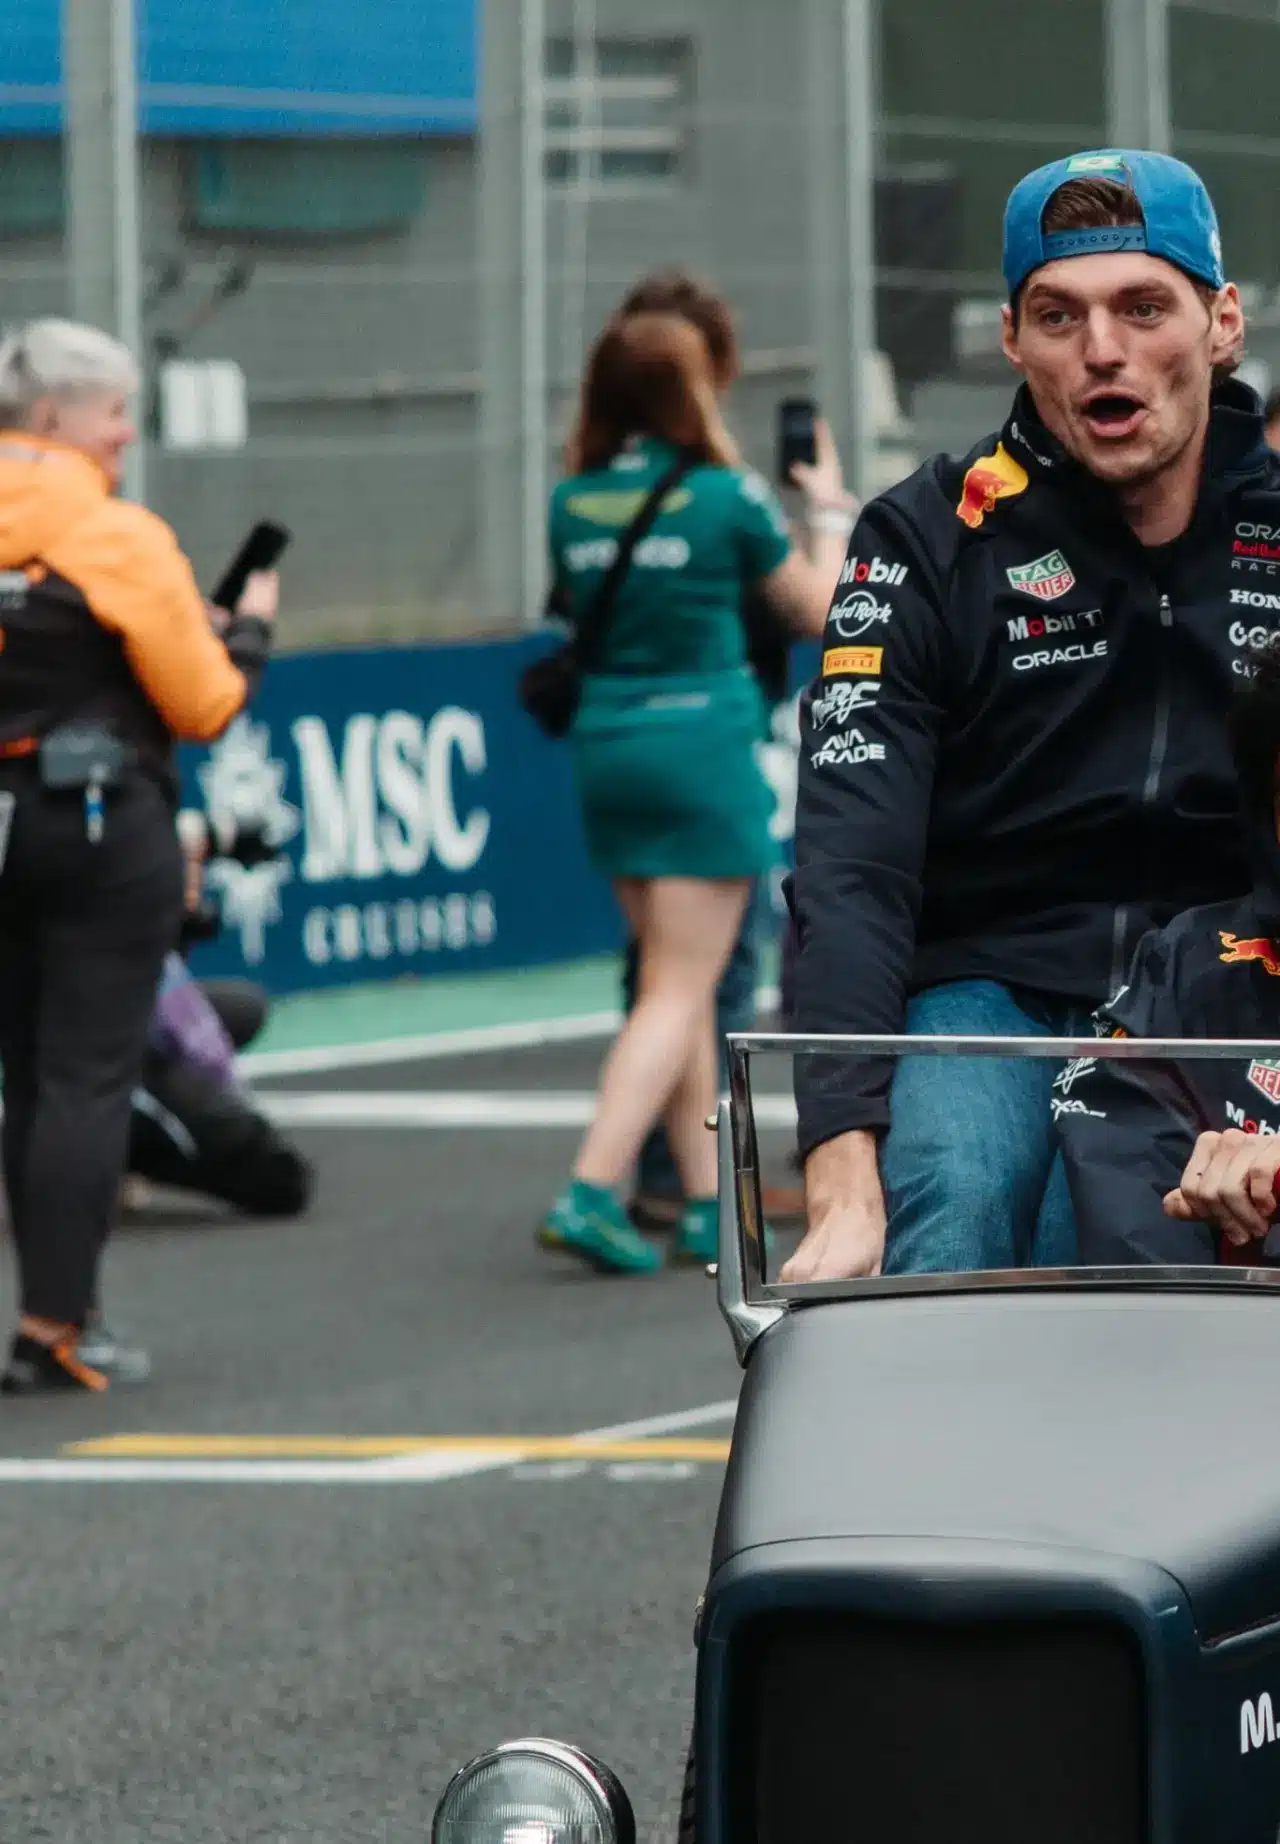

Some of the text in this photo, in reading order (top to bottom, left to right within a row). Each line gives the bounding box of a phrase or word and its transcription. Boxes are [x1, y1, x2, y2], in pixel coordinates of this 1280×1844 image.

[1232, 538, 1258, 555] Red
[839, 556, 909, 587] Mobil
[1013, 555, 1064, 582] TAG
[1014, 573, 1073, 598] HEUER
[854, 600, 893, 624] Rock
[1006, 613, 1077, 642] Mobil
[1012, 640, 1109, 671] ORACLE
[821, 728, 866, 751] AVA
[810, 743, 887, 770] TRADE
[292, 705, 491, 883] MSC
